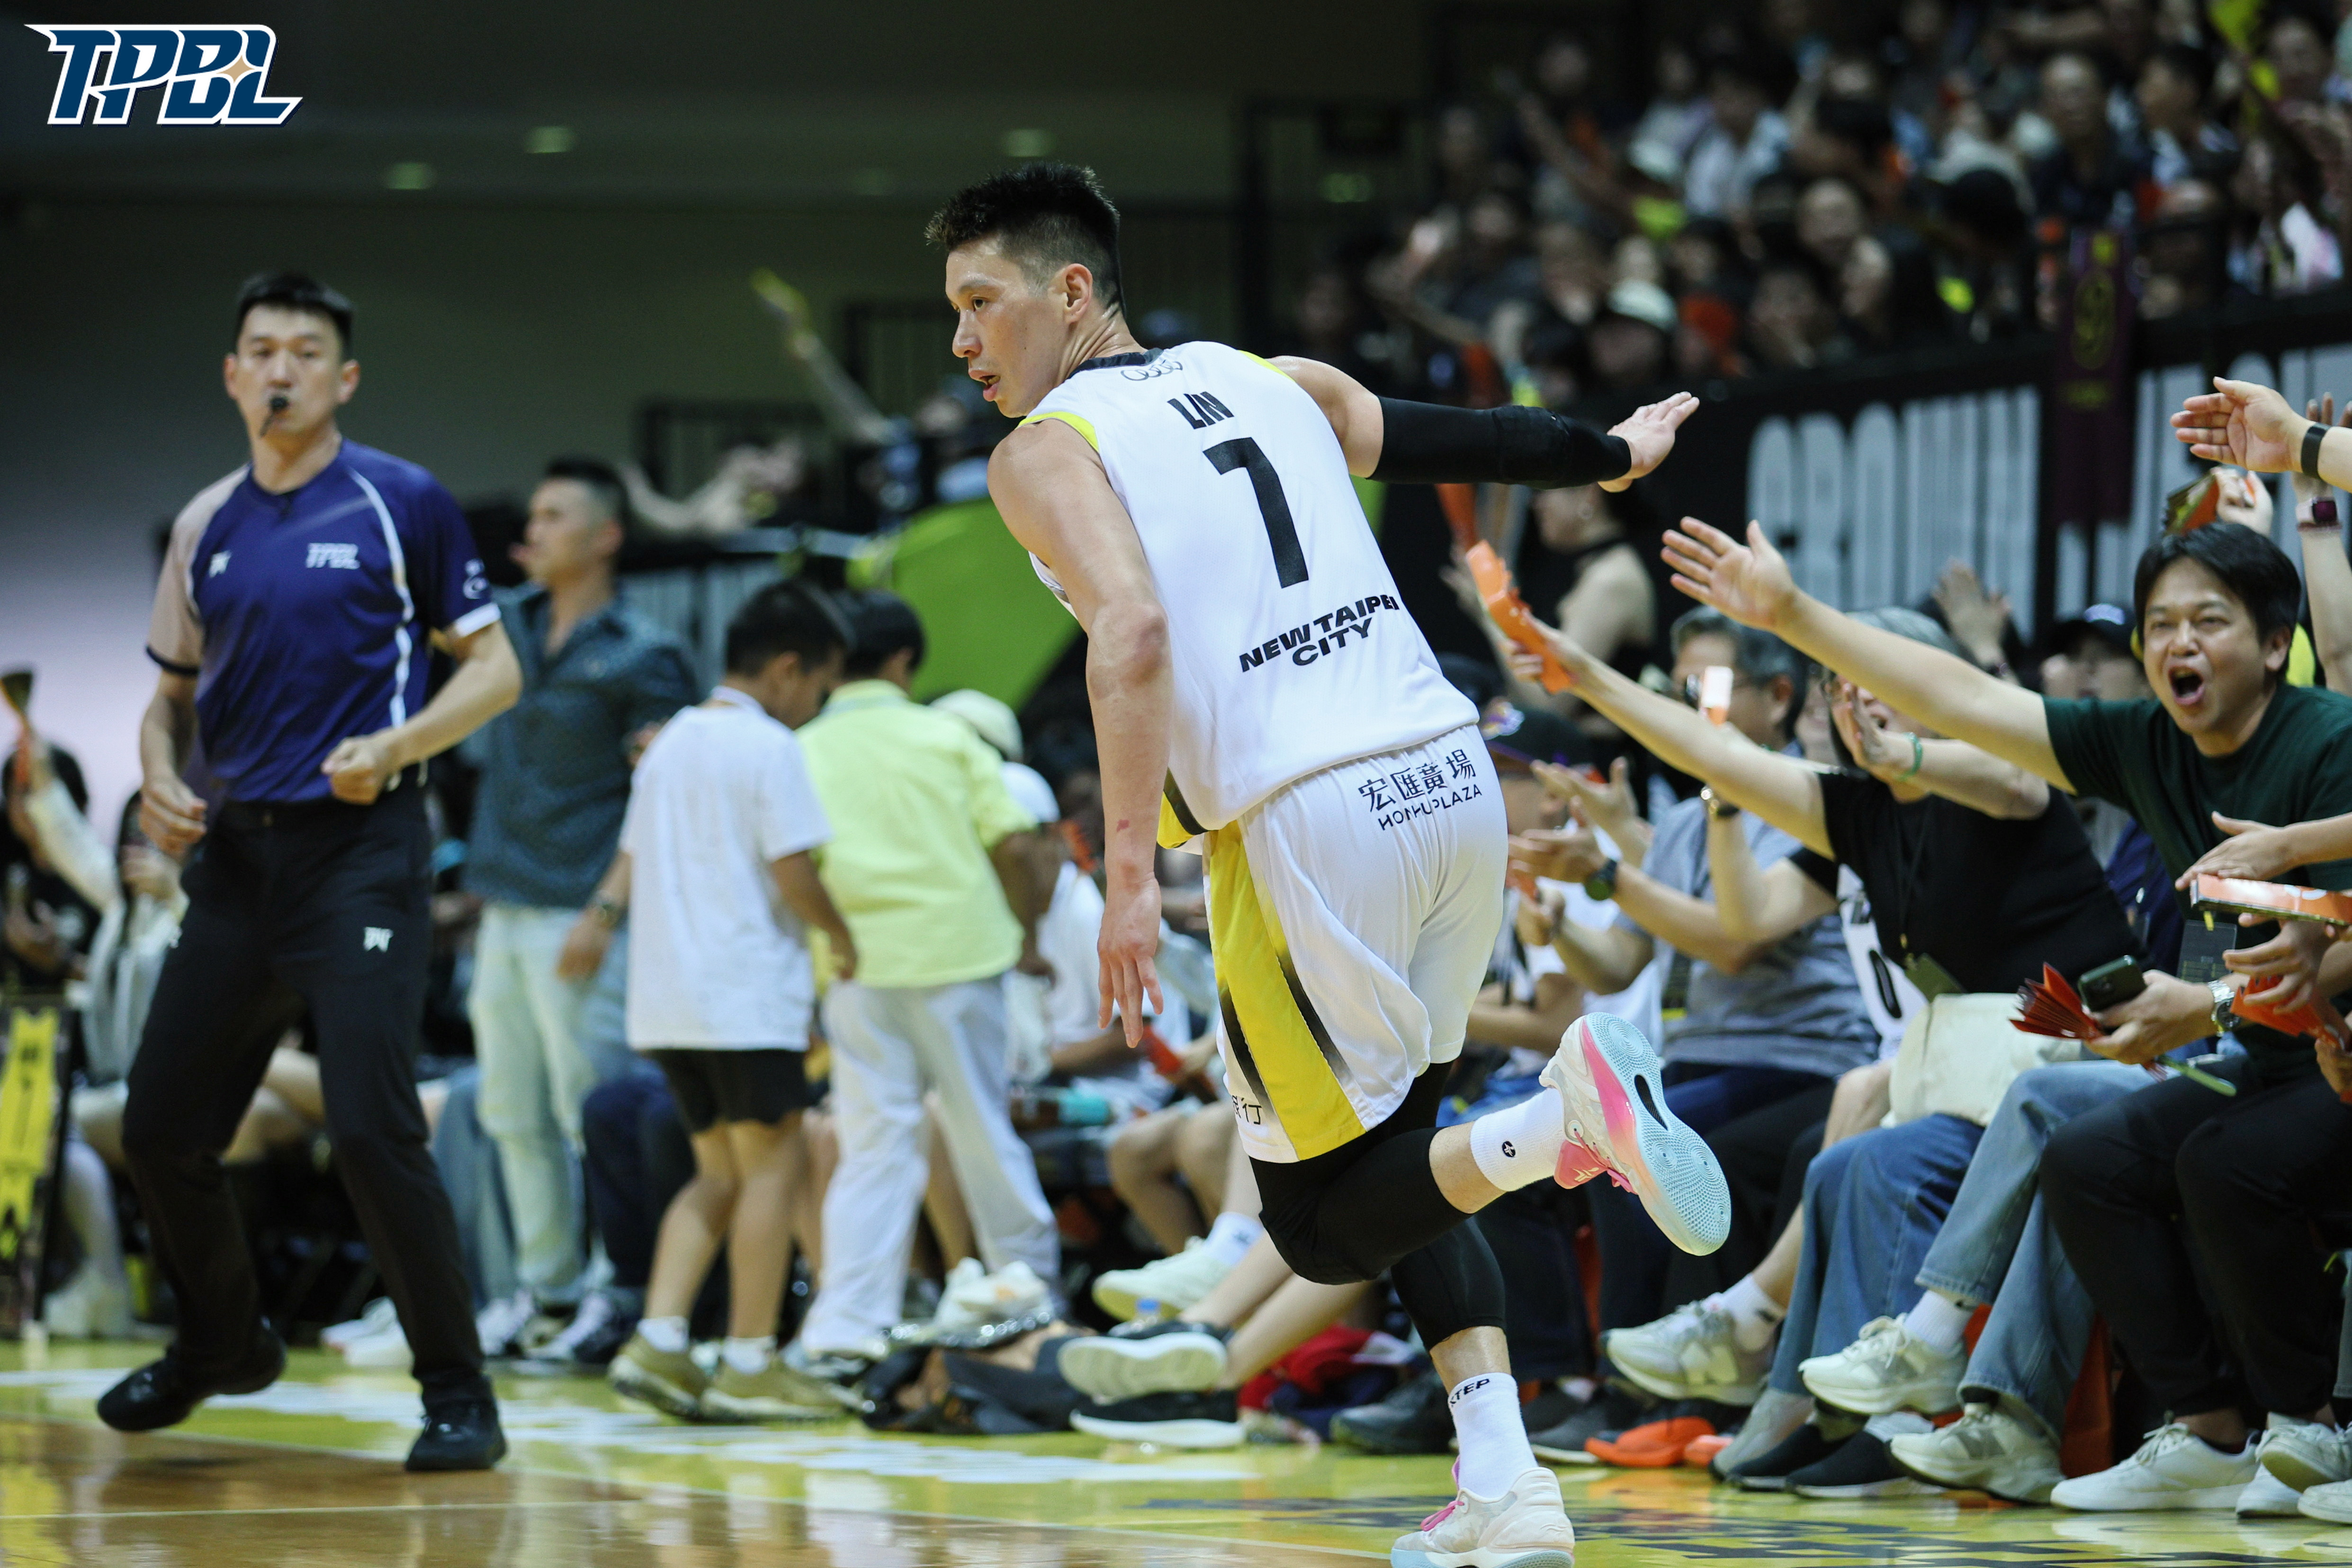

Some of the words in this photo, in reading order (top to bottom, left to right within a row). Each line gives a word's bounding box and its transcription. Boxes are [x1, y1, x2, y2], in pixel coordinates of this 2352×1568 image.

[1167, 391, 1235, 430] LIN
[1203, 437, 1309, 589] 7
[1239, 623, 1311, 672] NEW
[1313, 594, 1400, 633] TAIPEI
[1292, 617, 1373, 666] CITY
